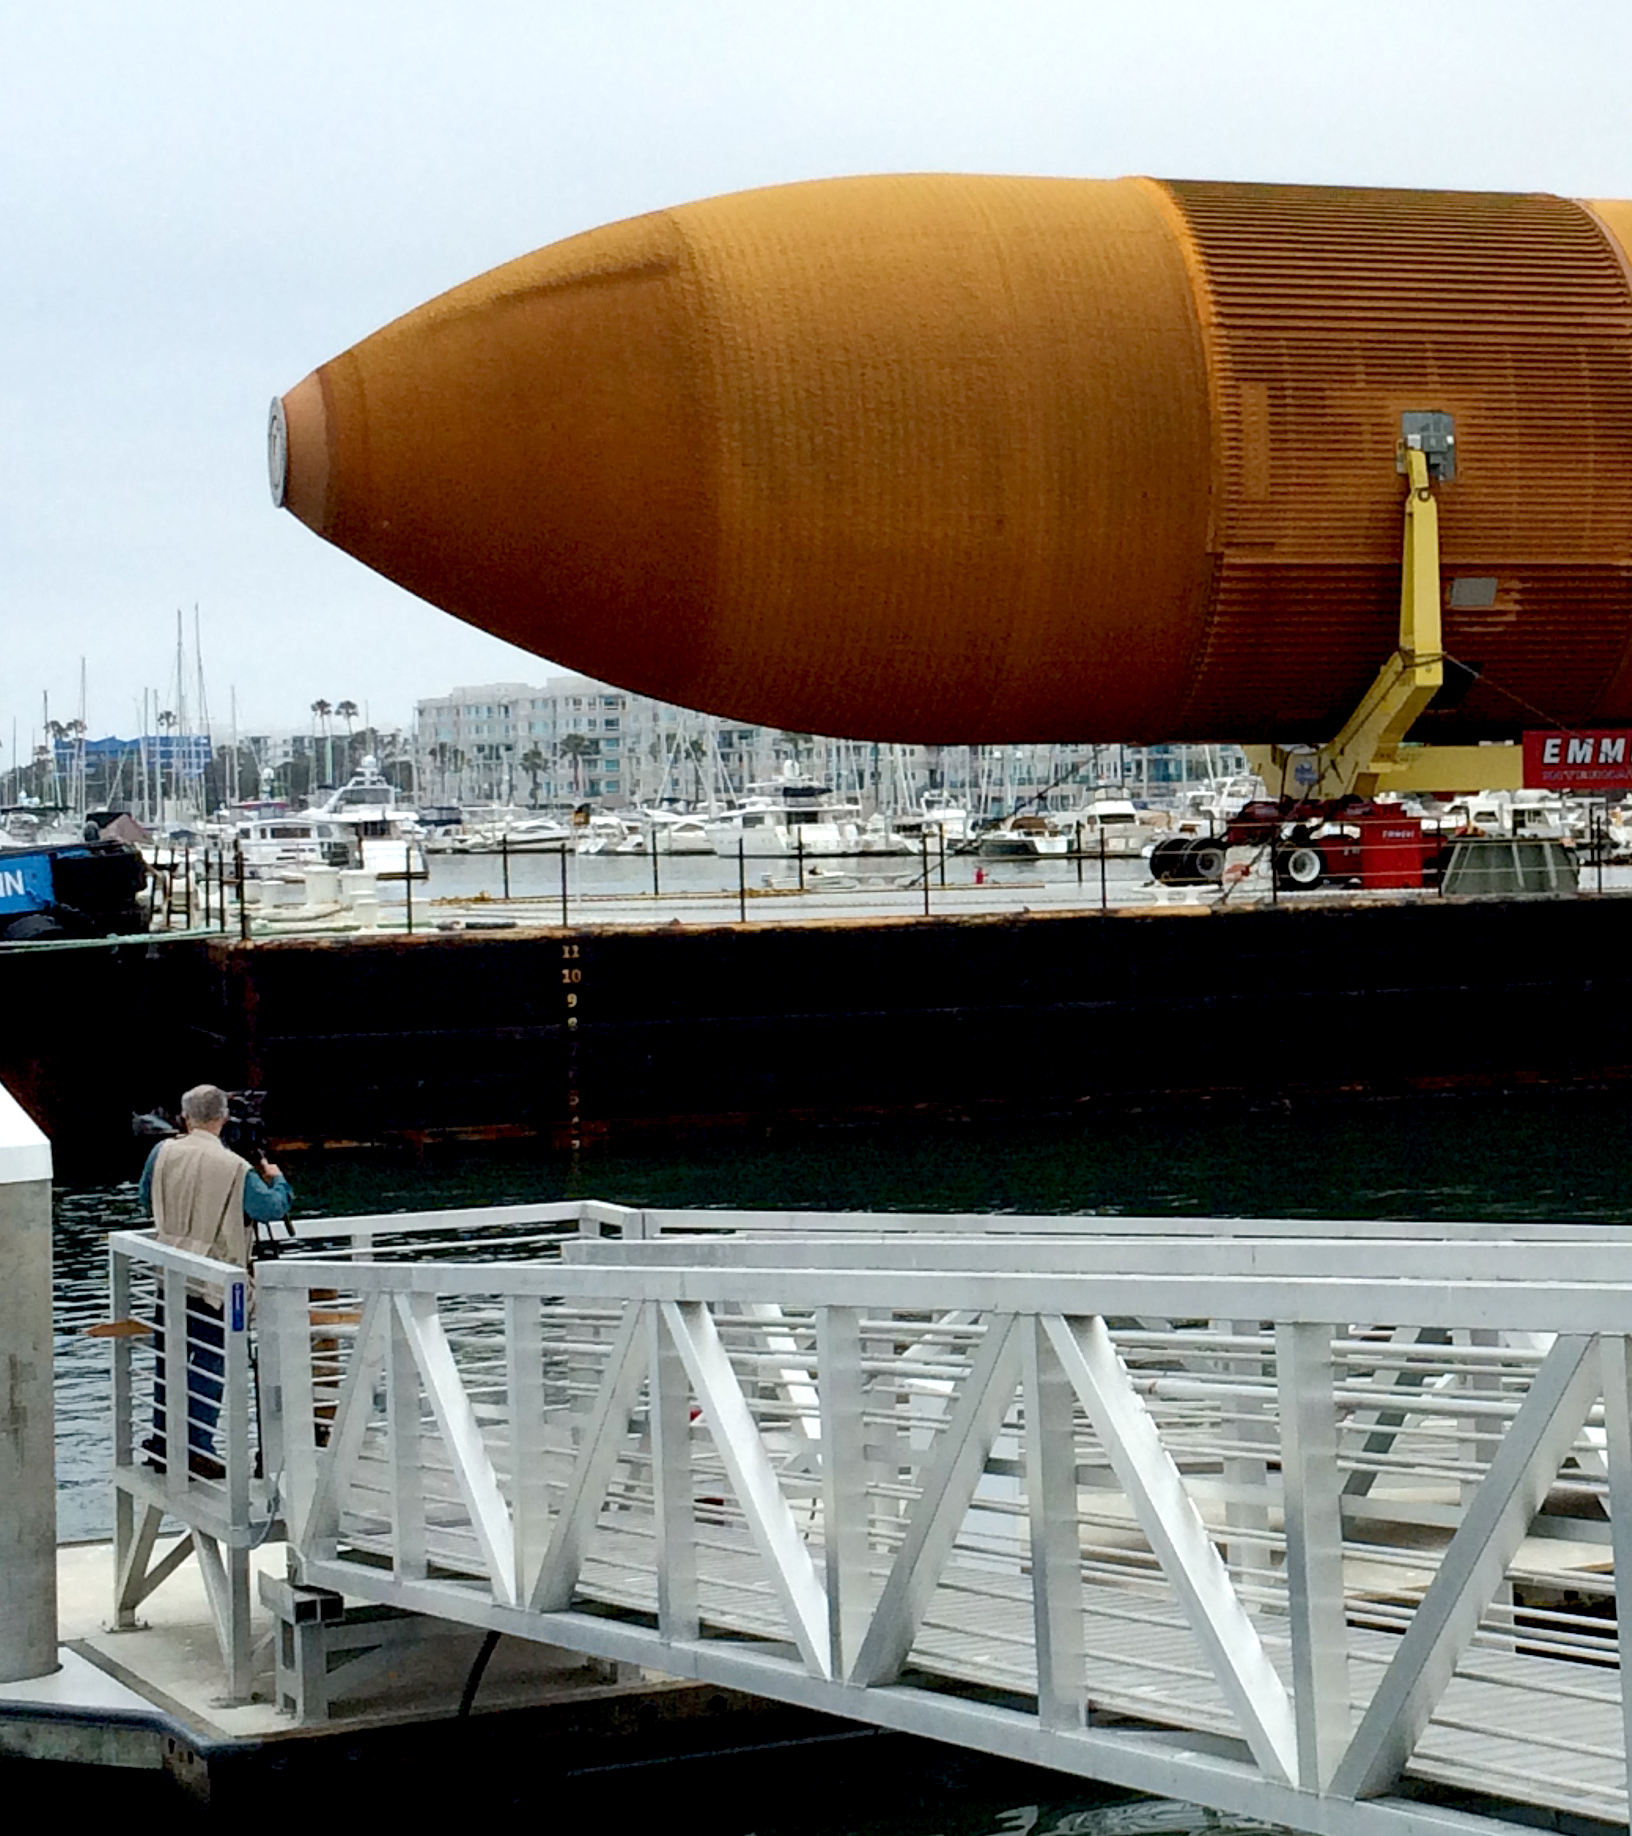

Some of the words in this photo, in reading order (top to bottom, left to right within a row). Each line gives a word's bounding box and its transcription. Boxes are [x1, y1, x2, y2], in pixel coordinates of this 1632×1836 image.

[561, 944, 580, 959] 11
[561, 968, 582, 983] 10
[566, 993, 578, 1008] 9
